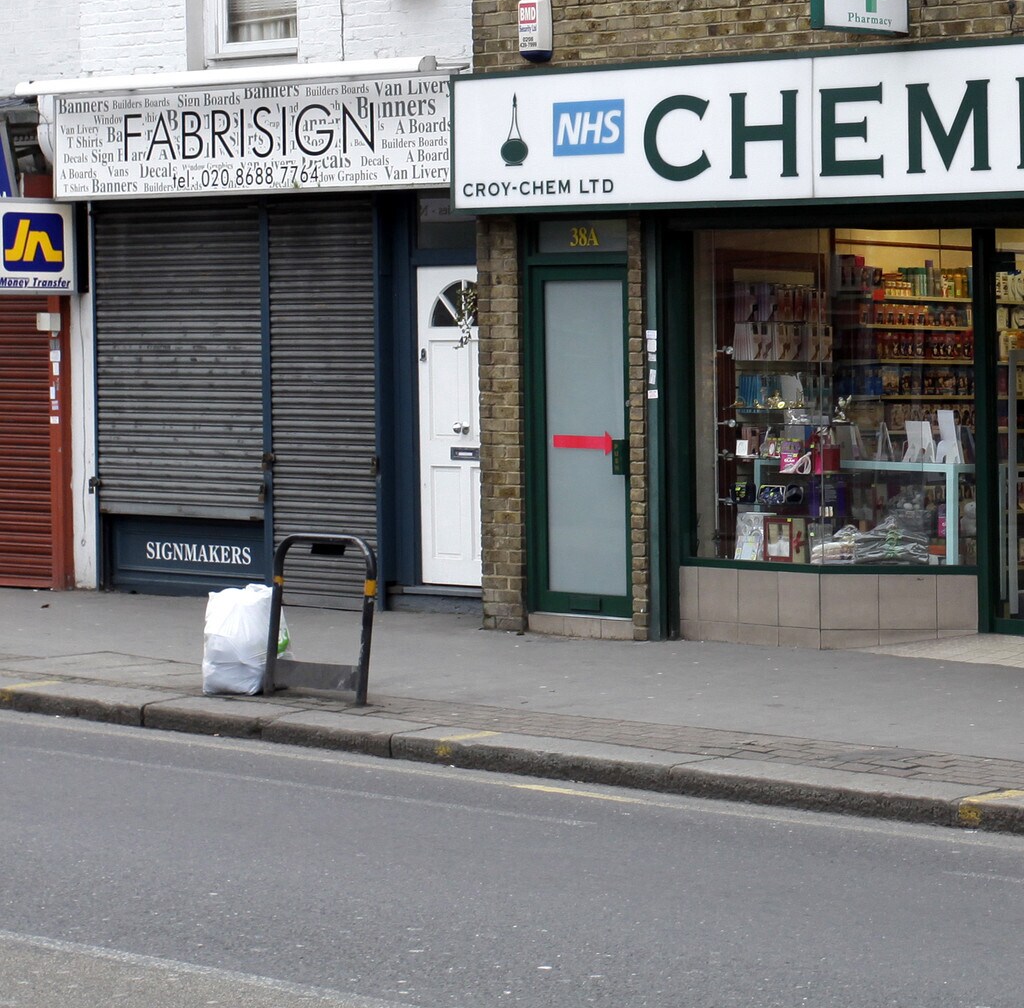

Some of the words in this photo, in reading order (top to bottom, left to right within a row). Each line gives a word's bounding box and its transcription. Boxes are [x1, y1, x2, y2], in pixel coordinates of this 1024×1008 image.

[520, 7, 536, 21] BMD
[848, 12, 892, 27] Pharmacy
[59, 98, 109, 114] Banners
[113, 99, 142, 110] Builders
[145, 98, 170, 107] Boards
[178, 94, 200, 108] Sign
[204, 91, 240, 106] Boards
[244, 84, 299, 100] Banners
[306, 86, 339, 97] Builders
[341, 84, 369, 94] Boards
[375, 81, 402, 97] Van
[408, 79, 450, 97] Livery
[60, 125, 75, 135] Van
[77, 123, 99, 136] Livery
[123, 102, 375, 162] FABRISIGN
[395, 120, 405, 134] A
[557, 110, 621, 145] NHS
[67, 137, 73, 148] T
[76, 135, 103, 148] Shirts
[382, 138, 416, 150] Builders
[418, 136, 448, 147] Boards
[63, 153, 88, 164] Decals
[92, 149, 114, 166] Sign
[361, 154, 390, 167] Decals
[406, 150, 414, 163] A
[60, 169, 66, 179] A
[69, 168, 97, 179] Boards
[108, 166, 129, 177] Vans
[140, 162, 177, 179] Decals
[173, 170, 195, 188] tel:
[201, 169, 229, 187] 020
[235, 167, 273, 185] 8688
[280, 165, 319, 183] 7764
[337, 170, 378, 183] Graphics
[385, 166, 407, 181] Van
[412, 164, 449, 181] Livery
[64, 184, 68, 192] T
[70, 183, 90, 192] Shirts
[92, 179, 138, 193] Banners
[144, 182, 174, 192] Builders
[463, 179, 571, 198] CROY-CHEM
[579, 178, 614, 194] LTD
[569, 227, 599, 247] 38A
[0, 277, 30, 289] Money
[33, 276, 71, 288] Transfer
[146, 541, 252, 565] SIGNMAKERS
